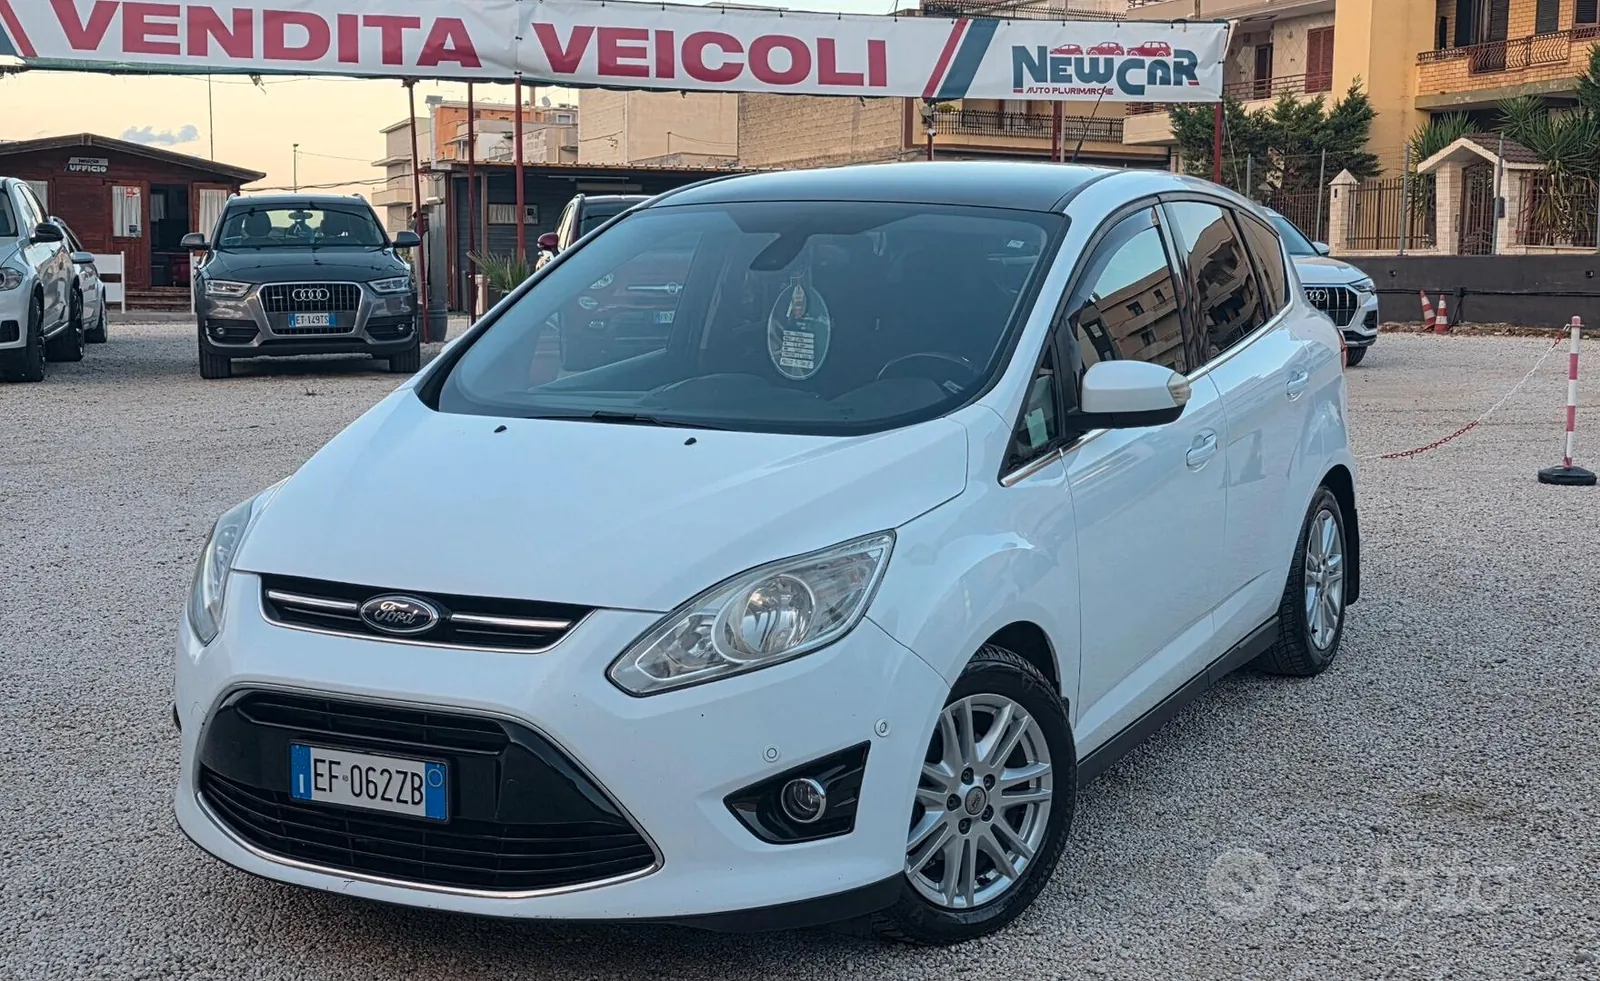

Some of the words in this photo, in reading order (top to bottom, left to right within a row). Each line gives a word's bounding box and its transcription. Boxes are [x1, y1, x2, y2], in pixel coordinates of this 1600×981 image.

[49, 0, 482, 68] VENDITA
[532, 22, 887, 87] VEICOLI
[1052, 87, 1114, 95] PLURIMARCHE
[70, 164, 107, 172] UFFICIO
[374, 601, 419, 625] Ford
[313, 758, 342, 793] EF
[350, 764, 424, 806] 062ZB
